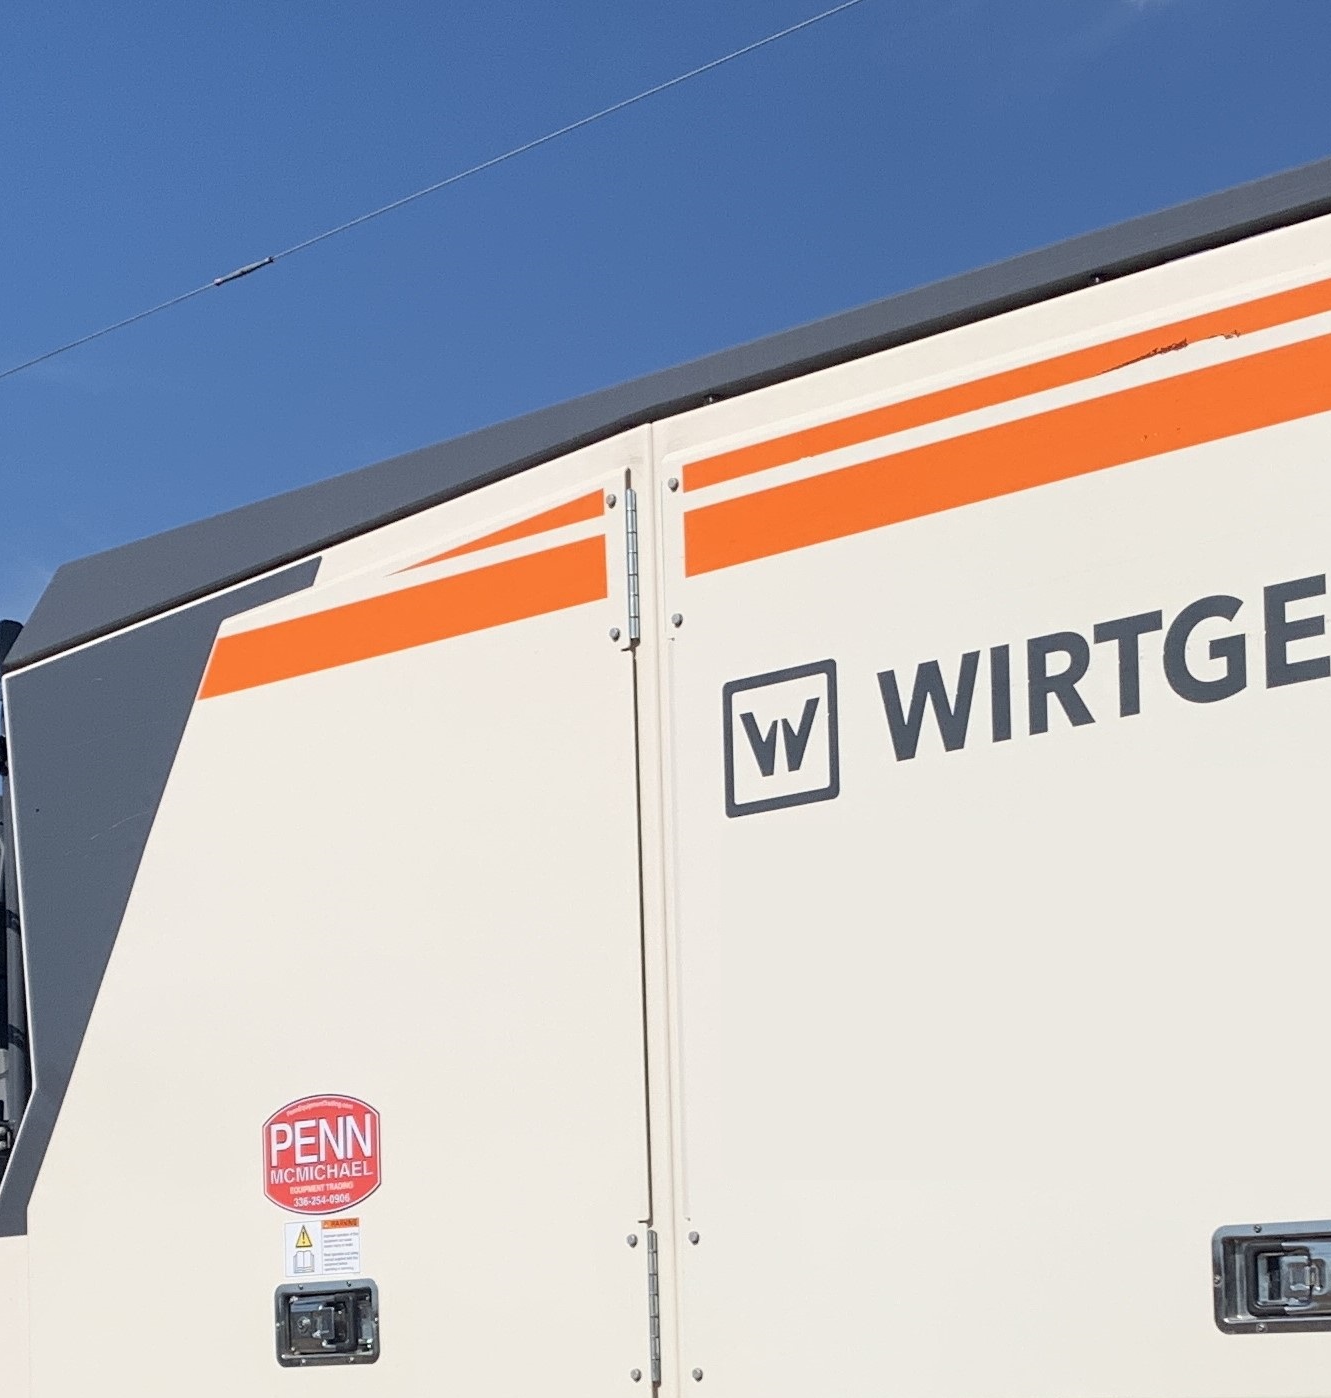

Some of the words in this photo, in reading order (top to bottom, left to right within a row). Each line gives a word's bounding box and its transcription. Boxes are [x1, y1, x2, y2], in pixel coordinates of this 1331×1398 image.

[270, 1113, 373, 1167] PENN
[270, 1160, 373, 1186] MCMICHAEL
[290, 1183, 325, 1195] EQUIPMENT
[326, 1181, 354, 1191] TRADING
[293, 1193, 351, 1208] 336-254-0906
